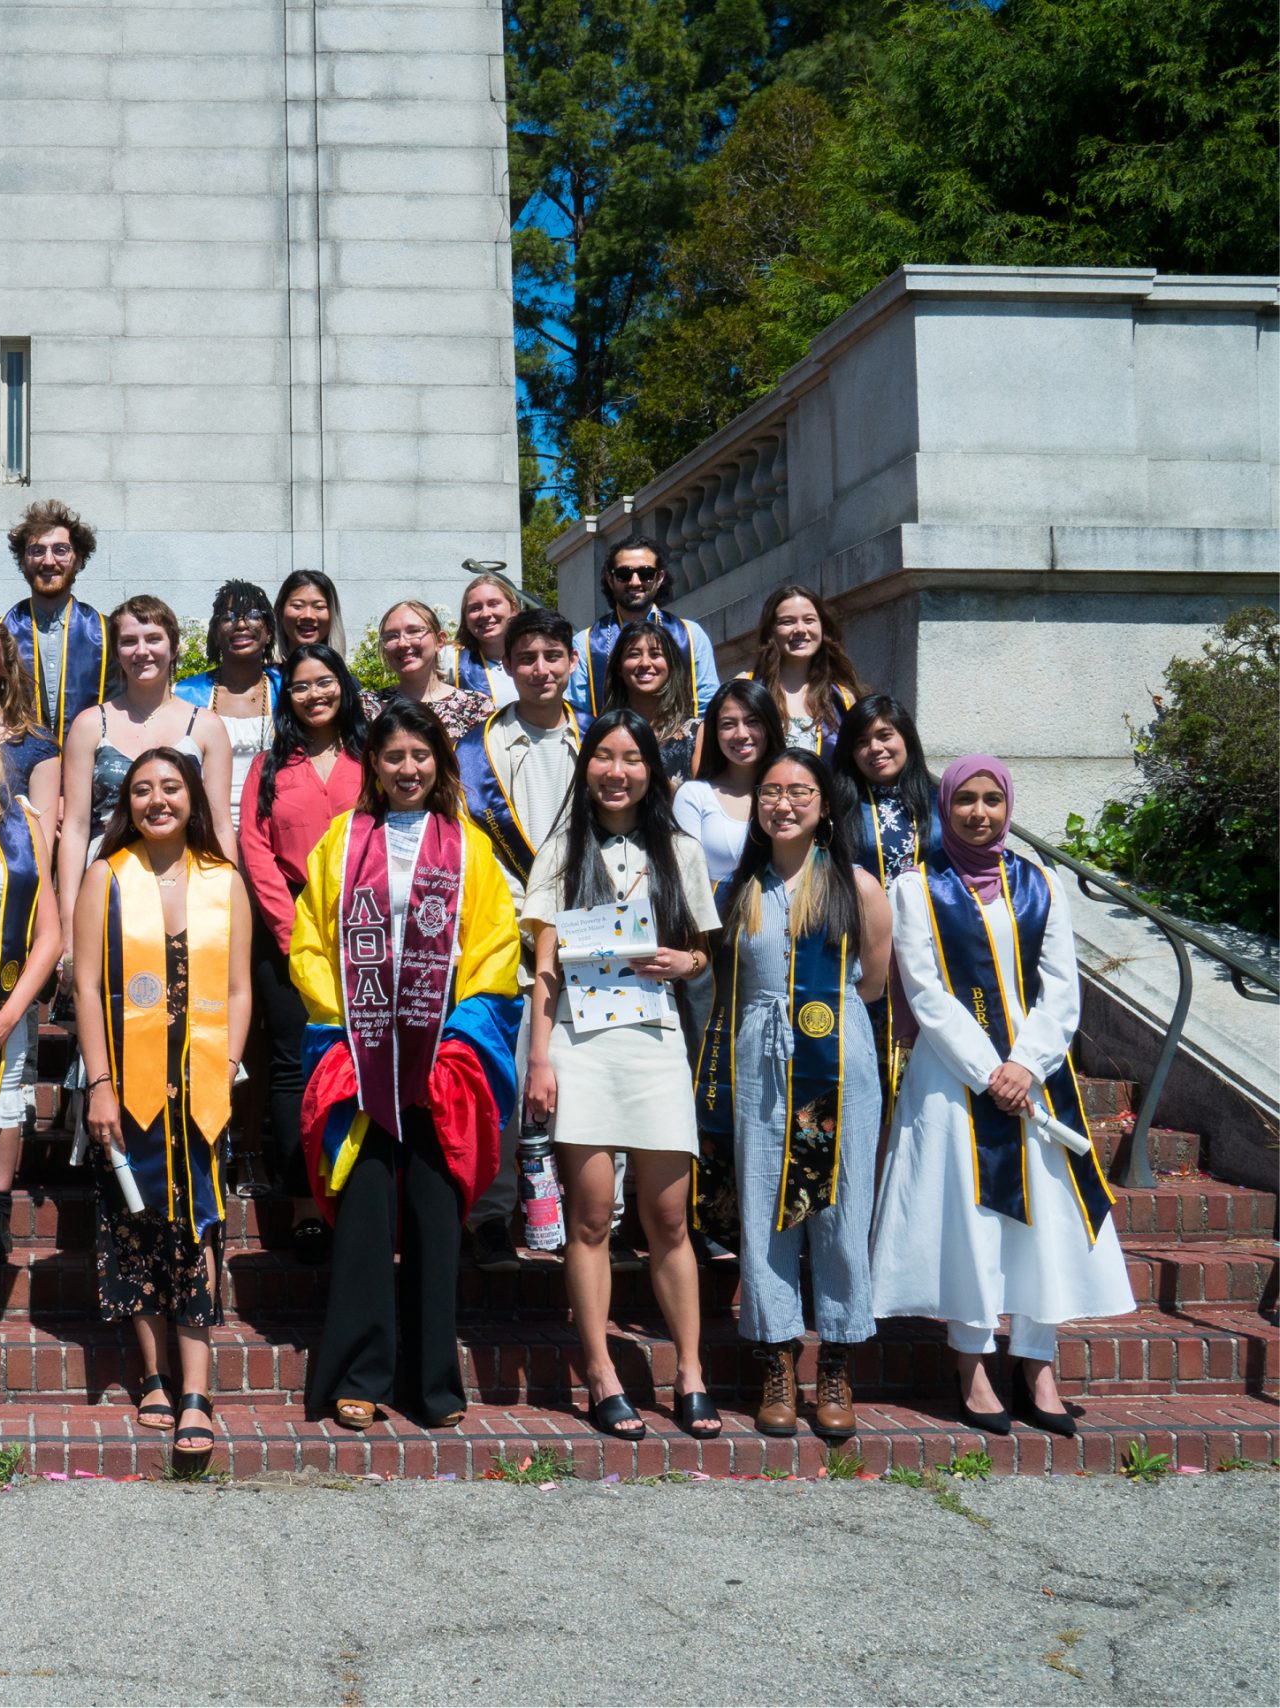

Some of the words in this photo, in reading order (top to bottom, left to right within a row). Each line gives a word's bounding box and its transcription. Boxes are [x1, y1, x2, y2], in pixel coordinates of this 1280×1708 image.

[415, 876, 430, 887] Class
[431, 879, 442, 889] of
[354, 1018, 372, 1030] Spring
[705, 1006, 726, 1112] BERKELEY
